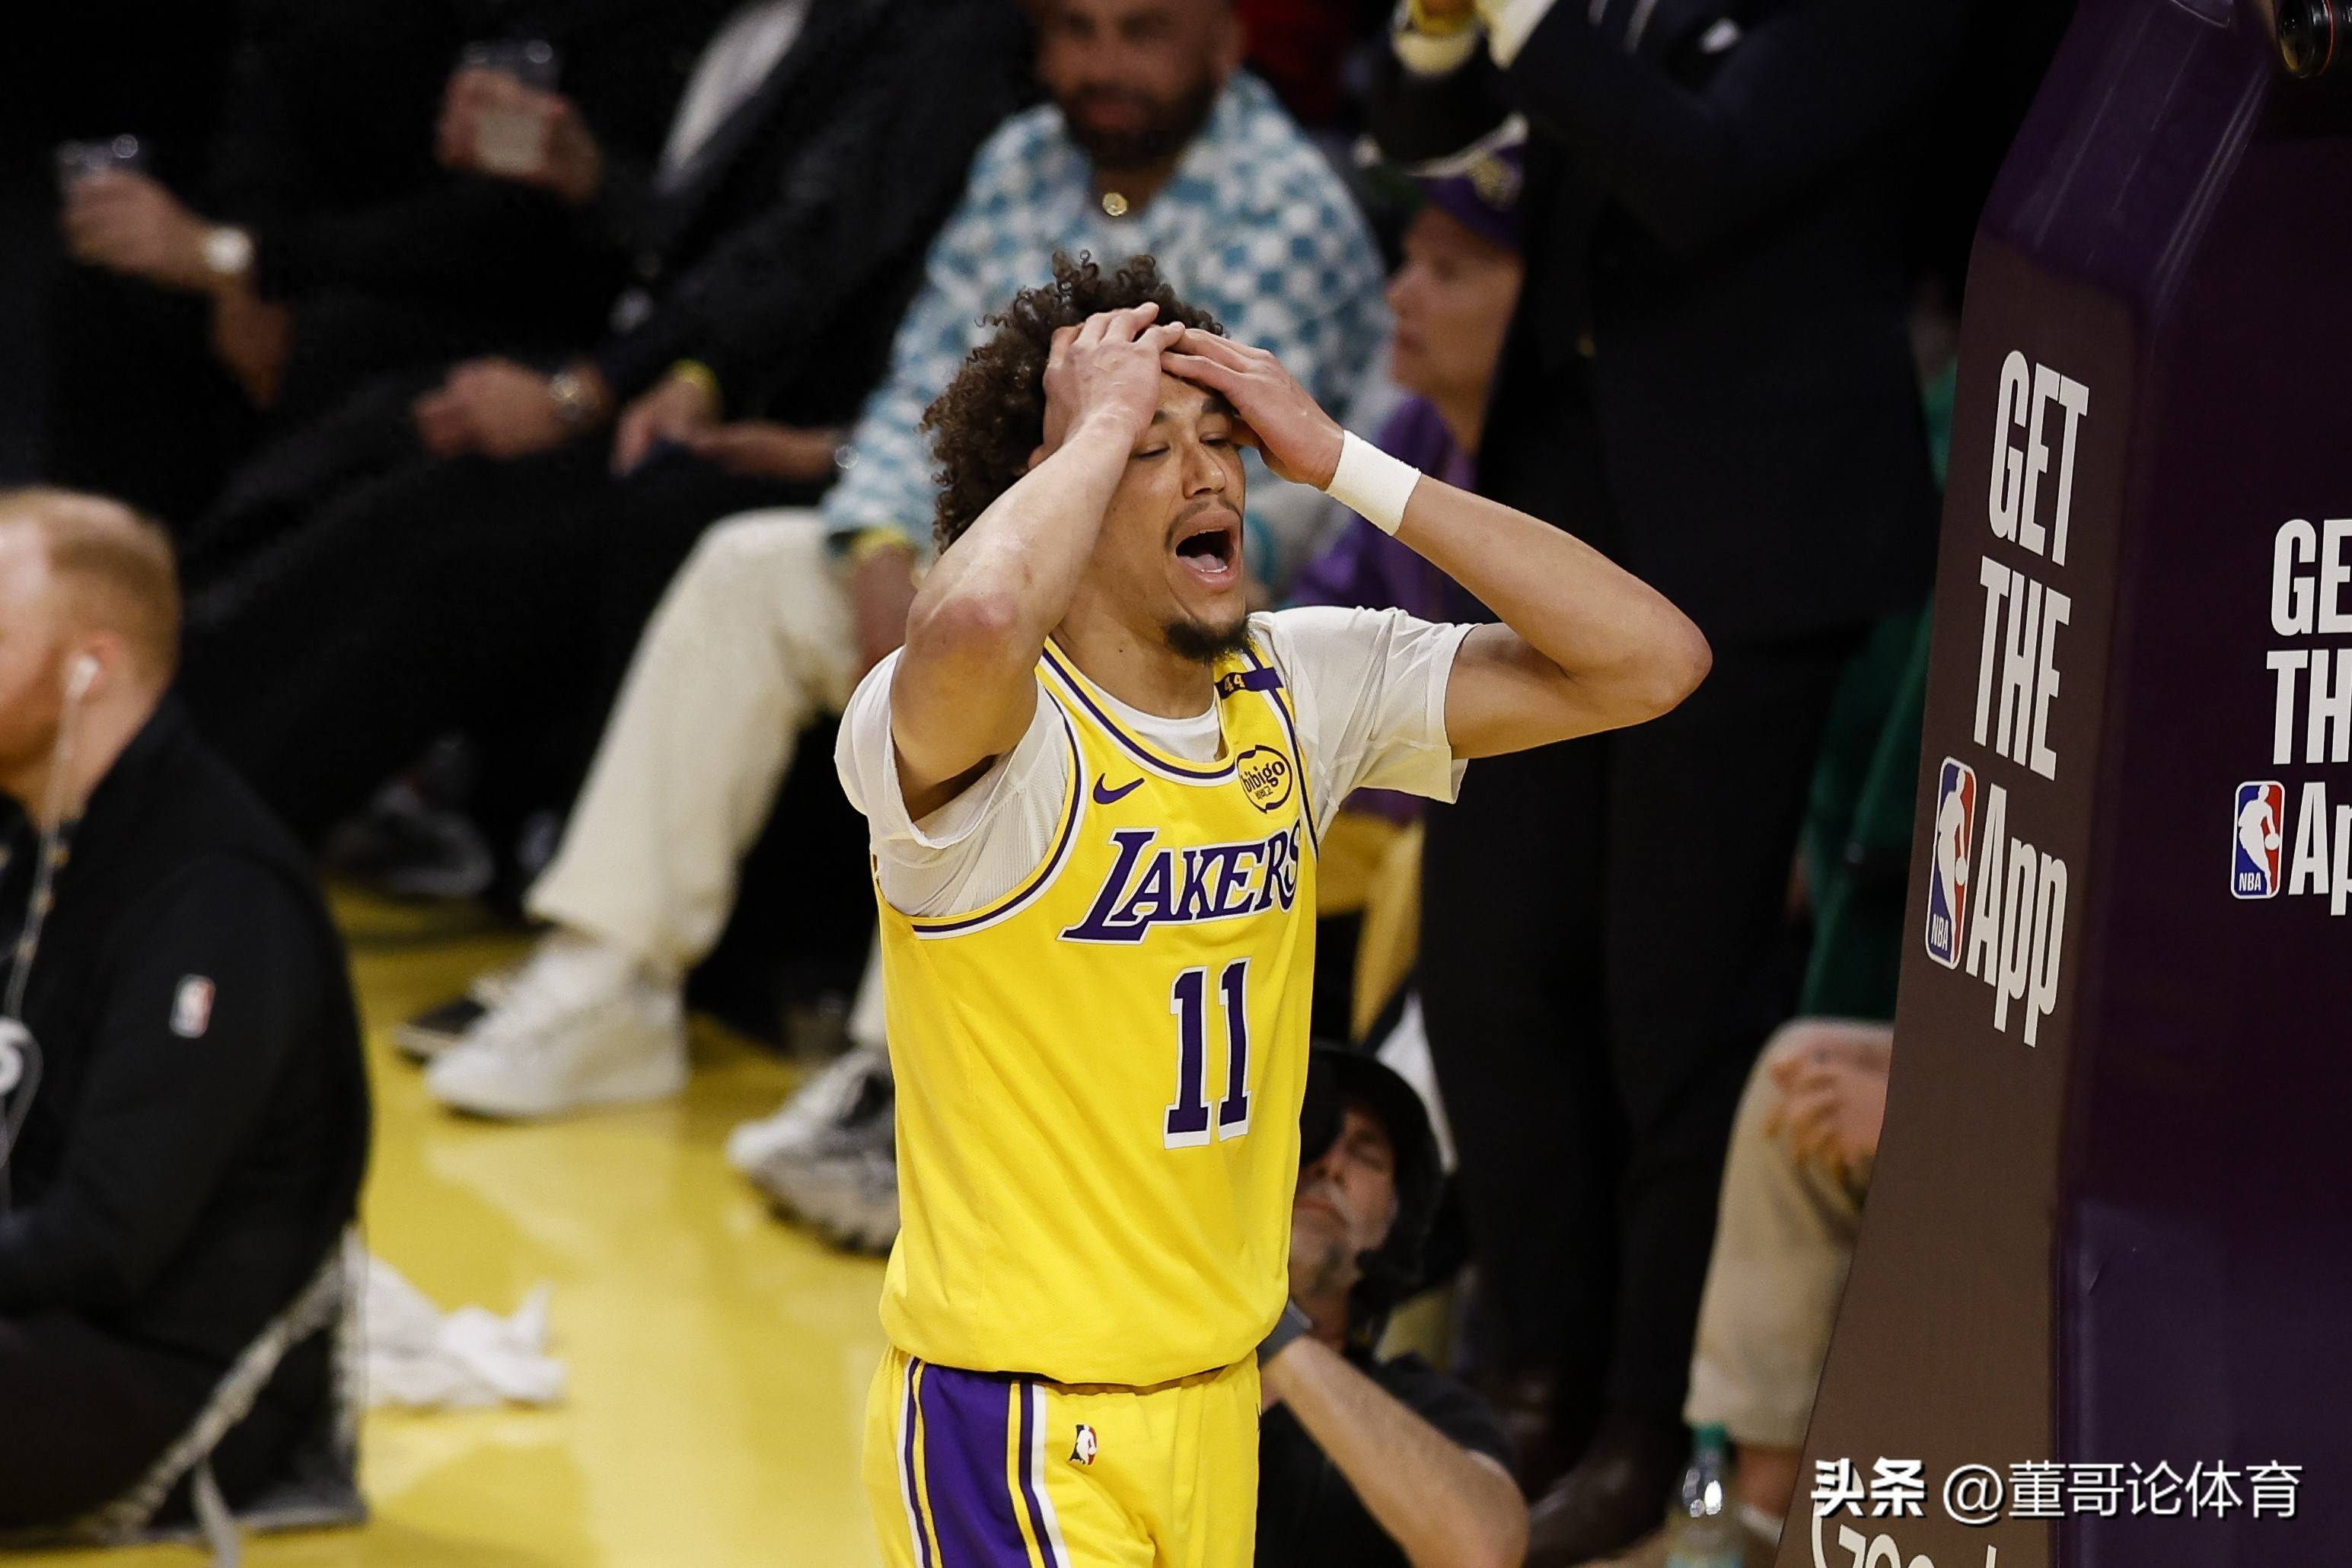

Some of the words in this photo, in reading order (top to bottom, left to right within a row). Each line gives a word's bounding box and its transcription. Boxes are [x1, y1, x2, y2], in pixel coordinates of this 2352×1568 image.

[1988, 349, 2089, 566] GET
[1224, 674, 1246, 692] 44
[1974, 555, 2071, 781] THE
[1240, 761, 1285, 792] bibigo
[1057, 817, 1301, 945] LAKERS
[1930, 913, 1949, 952] NBA
[1965, 782, 2068, 1047] App
[2239, 872, 2262, 892] NBA
[1164, 957, 1251, 1149] 11
